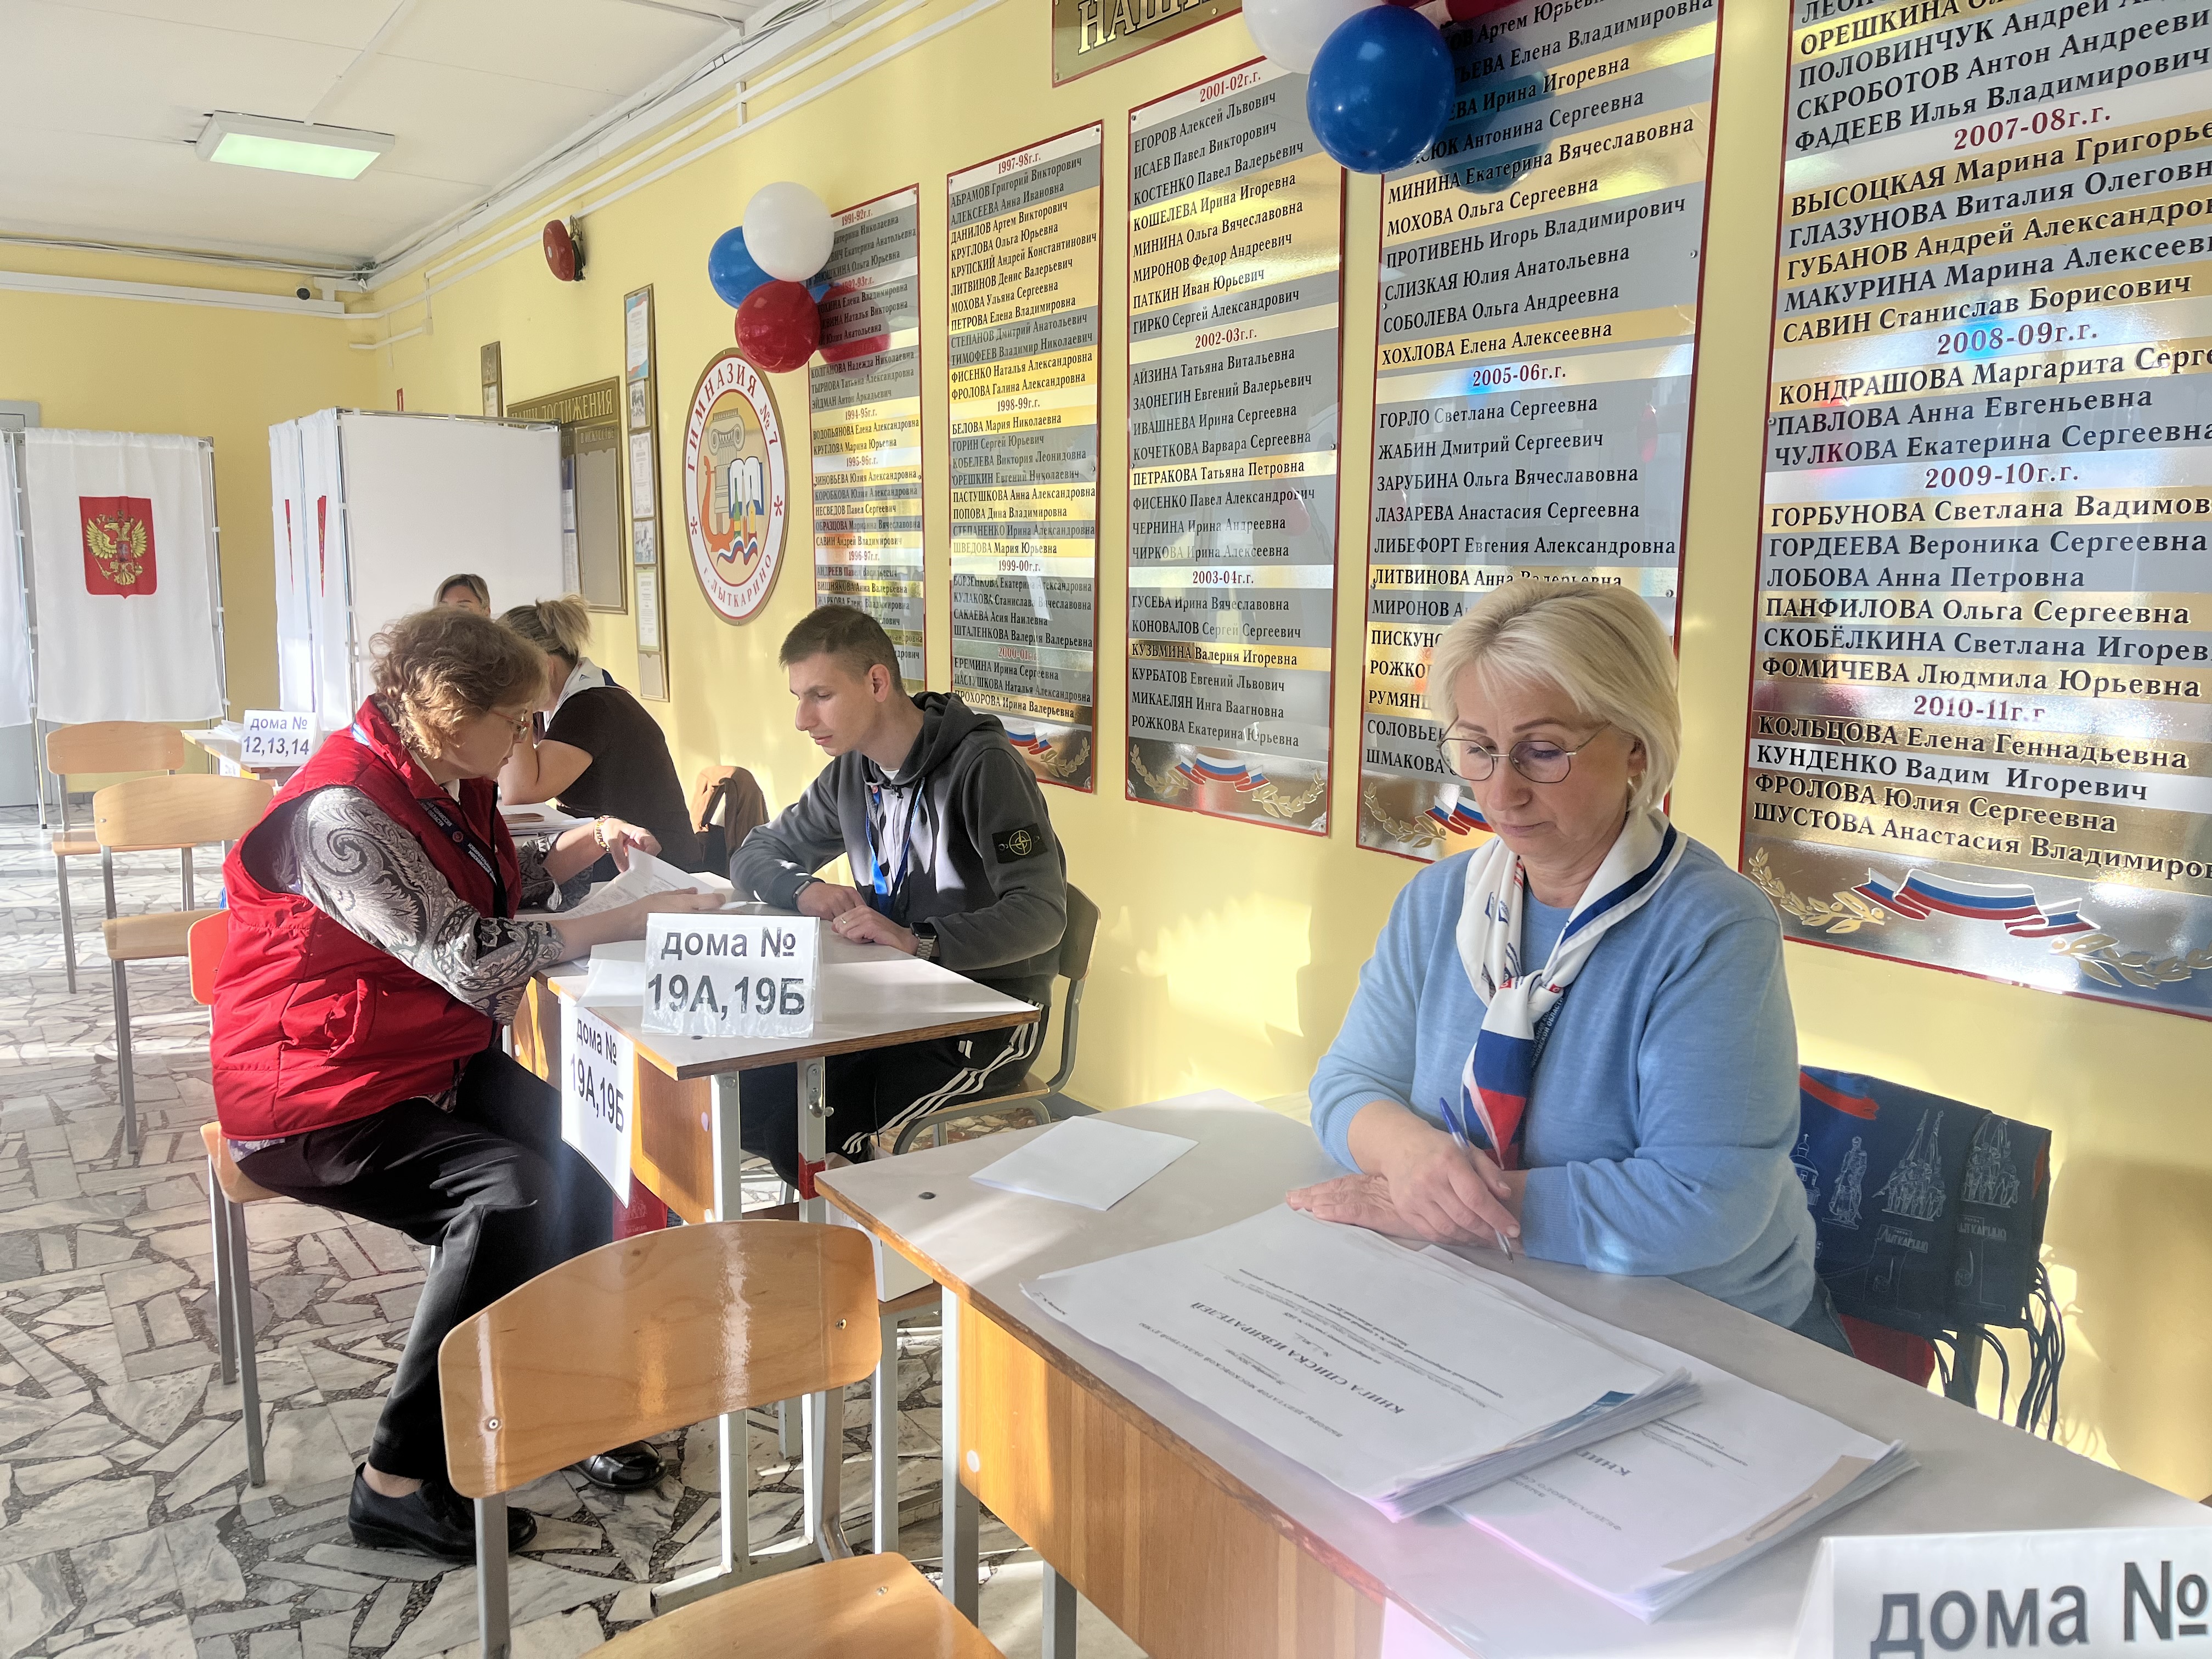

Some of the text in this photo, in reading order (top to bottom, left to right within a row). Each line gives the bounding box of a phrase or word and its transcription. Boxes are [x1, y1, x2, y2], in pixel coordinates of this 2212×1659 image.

[1078, 0, 1207, 55] НАШ
[1200, 71, 1261, 103] 2001-02г.г.
[1795, 45, 2211, 152] ФАДЕЕВ Илья Владимирович
[1134, 92, 1276, 154] ЕГОРОВ Алексей Львович
[1954, 104, 2112, 151] 2007-08г.г.
[998, 153, 1041, 174] 1997-98г.г.
[1134, 122, 1277, 179] ИСАЕВ Павел Викторович
[1387, 117, 1694, 205] МИНИНА Екатерина Вячеславовна
[1791, 148, 2064, 218] ВЫСОЦКАЯ Марина
[951, 201, 1068, 245] ДАНИЛОВ Артем Викторович
[1133, 200, 1304, 257] МИНИНА Ольга Вячеславовна
[1386, 198, 1685, 269] ПРОТИВЕНЬ Игорь Владимирович
[1133, 269, 1265, 309] ПАТКИН Иван Юрьевич
[951, 297, 1076, 331] ПЕТРОВА Елена Владимировна
[1384, 286, 1619, 334] СОБОЛЕВА Ольга Андреевна
[1782, 275, 2191, 343] САВИН Станислав Борисович
[1195, 328, 1257, 349] 2002-03г.г.
[1382, 324, 1612, 365] ХОХЛОВА Елена Алексеевна
[1937, 321, 2098, 356] 2008-09г.г.
[951, 352, 1092, 383] ФИСЕНКО Наталья Александровна
[1133, 348, 1295, 386] АЙЗИНА Татьяна Витальевна
[1472, 364, 1566, 387] 2005-06г.г.
[688, 363, 757, 472] ГИМНАЗИЯ
[997, 397, 1040, 412] 1998-99г.г.
[1380, 398, 1598, 428] ГОРЛО Светлана Сергеевна
[1776, 387, 2153, 436] ПАВЛОВА Анна Евгеньевна
[952, 415, 1061, 435] БЕЛОВА Мария Николаевна
[1133, 461, 1305, 486] ПЕТРАКОВА Татьяна Петровна
[1377, 468, 1638, 491] ЗАРУБИНА Ольга Вячеславовна
[1925, 462, 2078, 489] 2009-10г.г.
[1375, 502, 1640, 523] ЛАЗАРЕВА Анастасия Сергеевна
[1374, 537, 1675, 558] ЛИБЕФОРТ Евгения Александровна
[1769, 531, 2207, 560] ГОРДЕЕВА Вероника Сергеевна
[1193, 571, 1254, 585] 2003-04г.г.
[1373, 569, 1514, 586] ЛИТВИНОВА Анна
[1767, 566, 2085, 593] ЛОБОВА Анна Петровна
[1372, 599, 1449, 618] МИРОНОВ
[1766, 597, 2190, 628] ПАНФИЛОВА Ольга Сергеевна
[1132, 644, 1297, 668] КУЗЬМИНА Валерия Игоревна
[1764, 624, 2085, 658] СКОБЁЛКИНА Светлана
[955, 657, 1059, 680] ЕРЕМИНА Ирина Сергеевна
[1132, 667, 1285, 692] КУРБАТОВ Евгений Львович
[1762, 657, 2201, 699] ФОМИЧЕВА Людмила Юрьевна
[250, 716, 307, 731] дома №
[244, 736, 309, 757] 12,13,14
[1758, 715, 2188, 770] КОЛЬЦОВА Елена Геннадьевна
[1366, 748, 1445, 775] ШМАКОВА
[1756, 744, 2148, 802] КУНДЕНКО Вадим Игоревич
[1755, 774, 2117, 833] ФРОЛОВА Юлия Сергеевна
[662, 926, 796, 960] дома №
[647, 973, 805, 1020] 19А,19Б
[577, 1018, 617, 1066] дома №
[571, 1053, 624, 1133] 19А,19Б
[1189, 1301, 1288, 1351] ИЗБИРАТЕЛЕЙ
[1288, 1348, 1347, 1386] СПИСКА
[1351, 1384, 1406, 1414] КНИГА
[1576, 1450, 1632, 1477] КНИГ
[1870, 1560, 2208, 1659] дома №
